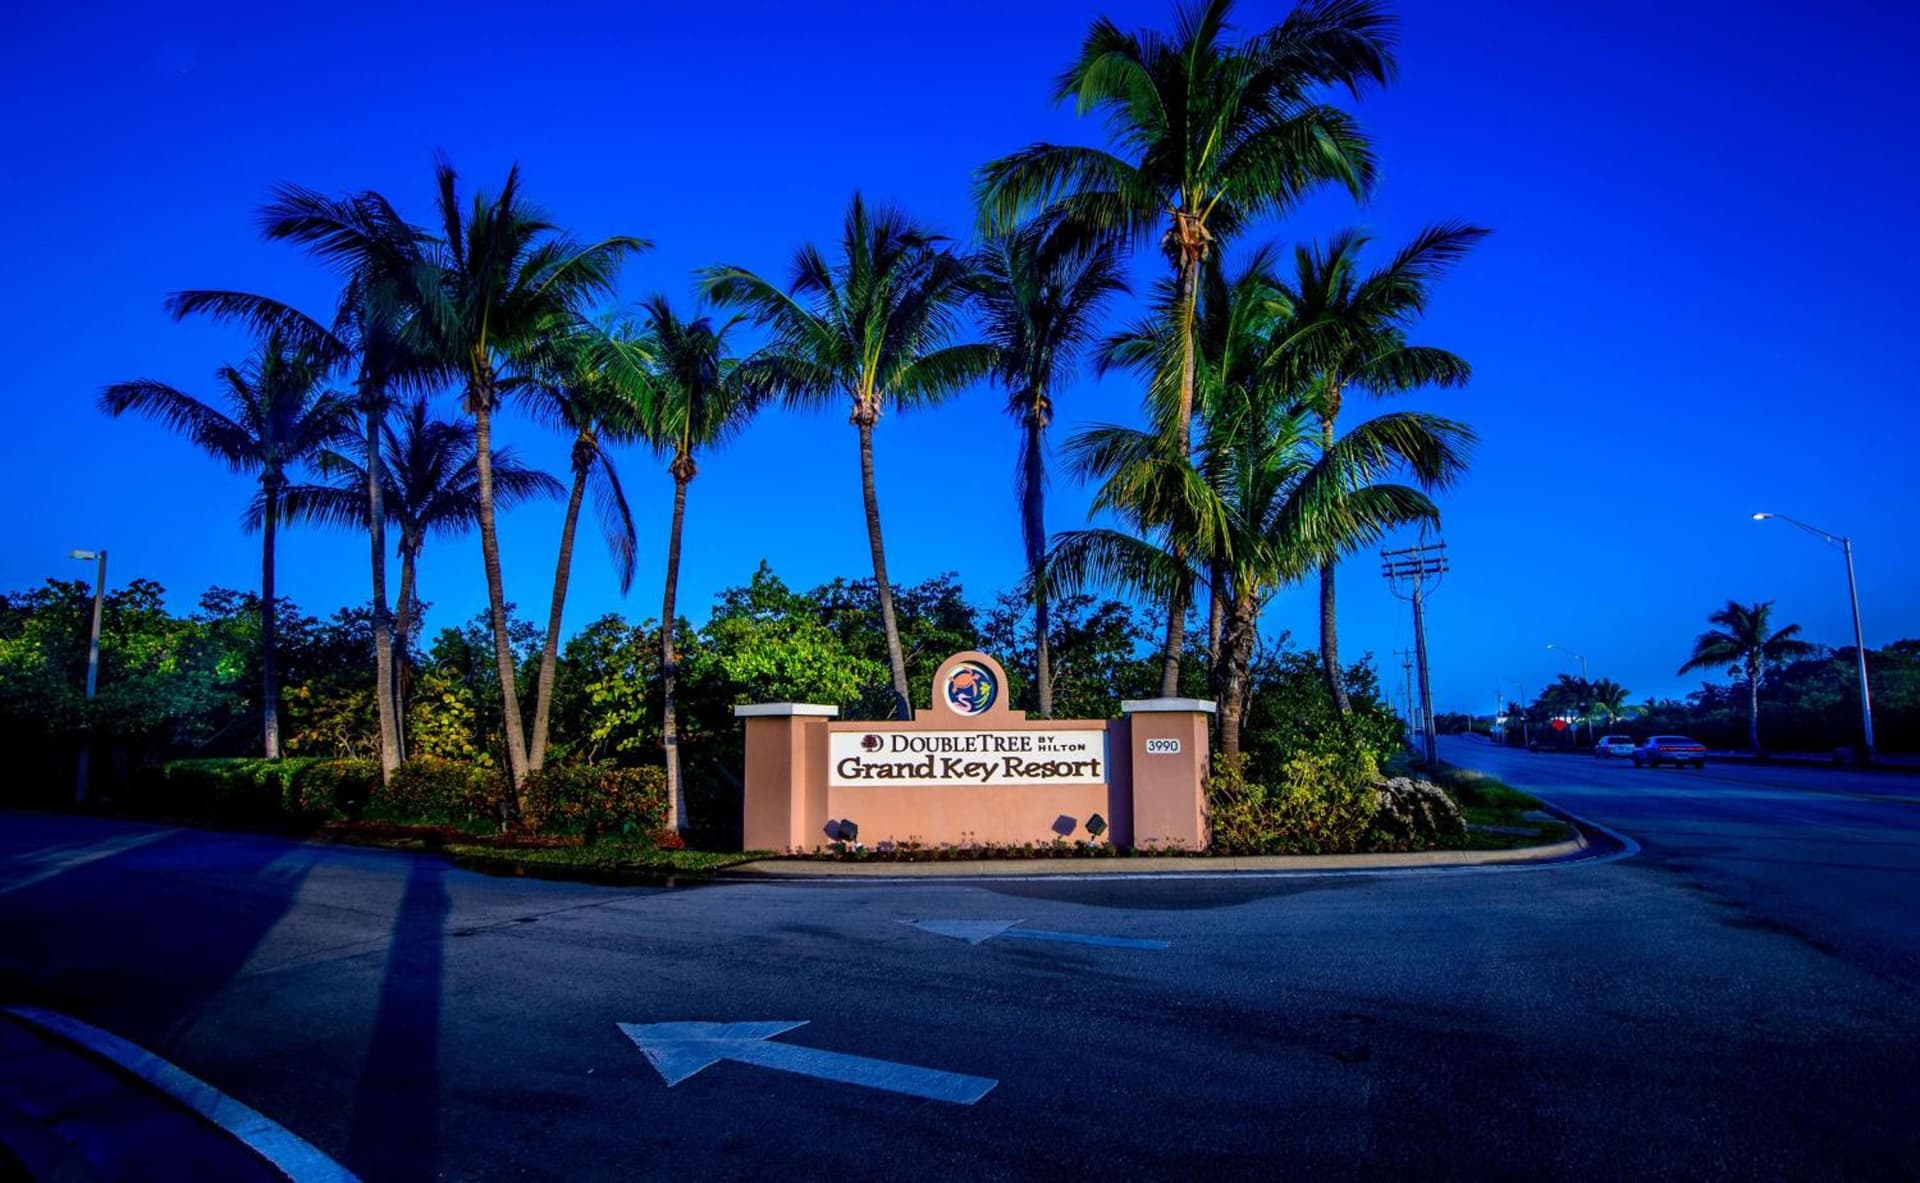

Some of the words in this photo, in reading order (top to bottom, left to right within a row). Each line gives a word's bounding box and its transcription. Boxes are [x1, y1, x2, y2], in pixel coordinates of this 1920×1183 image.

[1038, 744, 1086, 752] HILTON
[1148, 740, 1178, 751] 3990
[837, 754, 937, 779] Grand
[940, 757, 999, 782] Key
[1001, 756, 1101, 779] Resort
